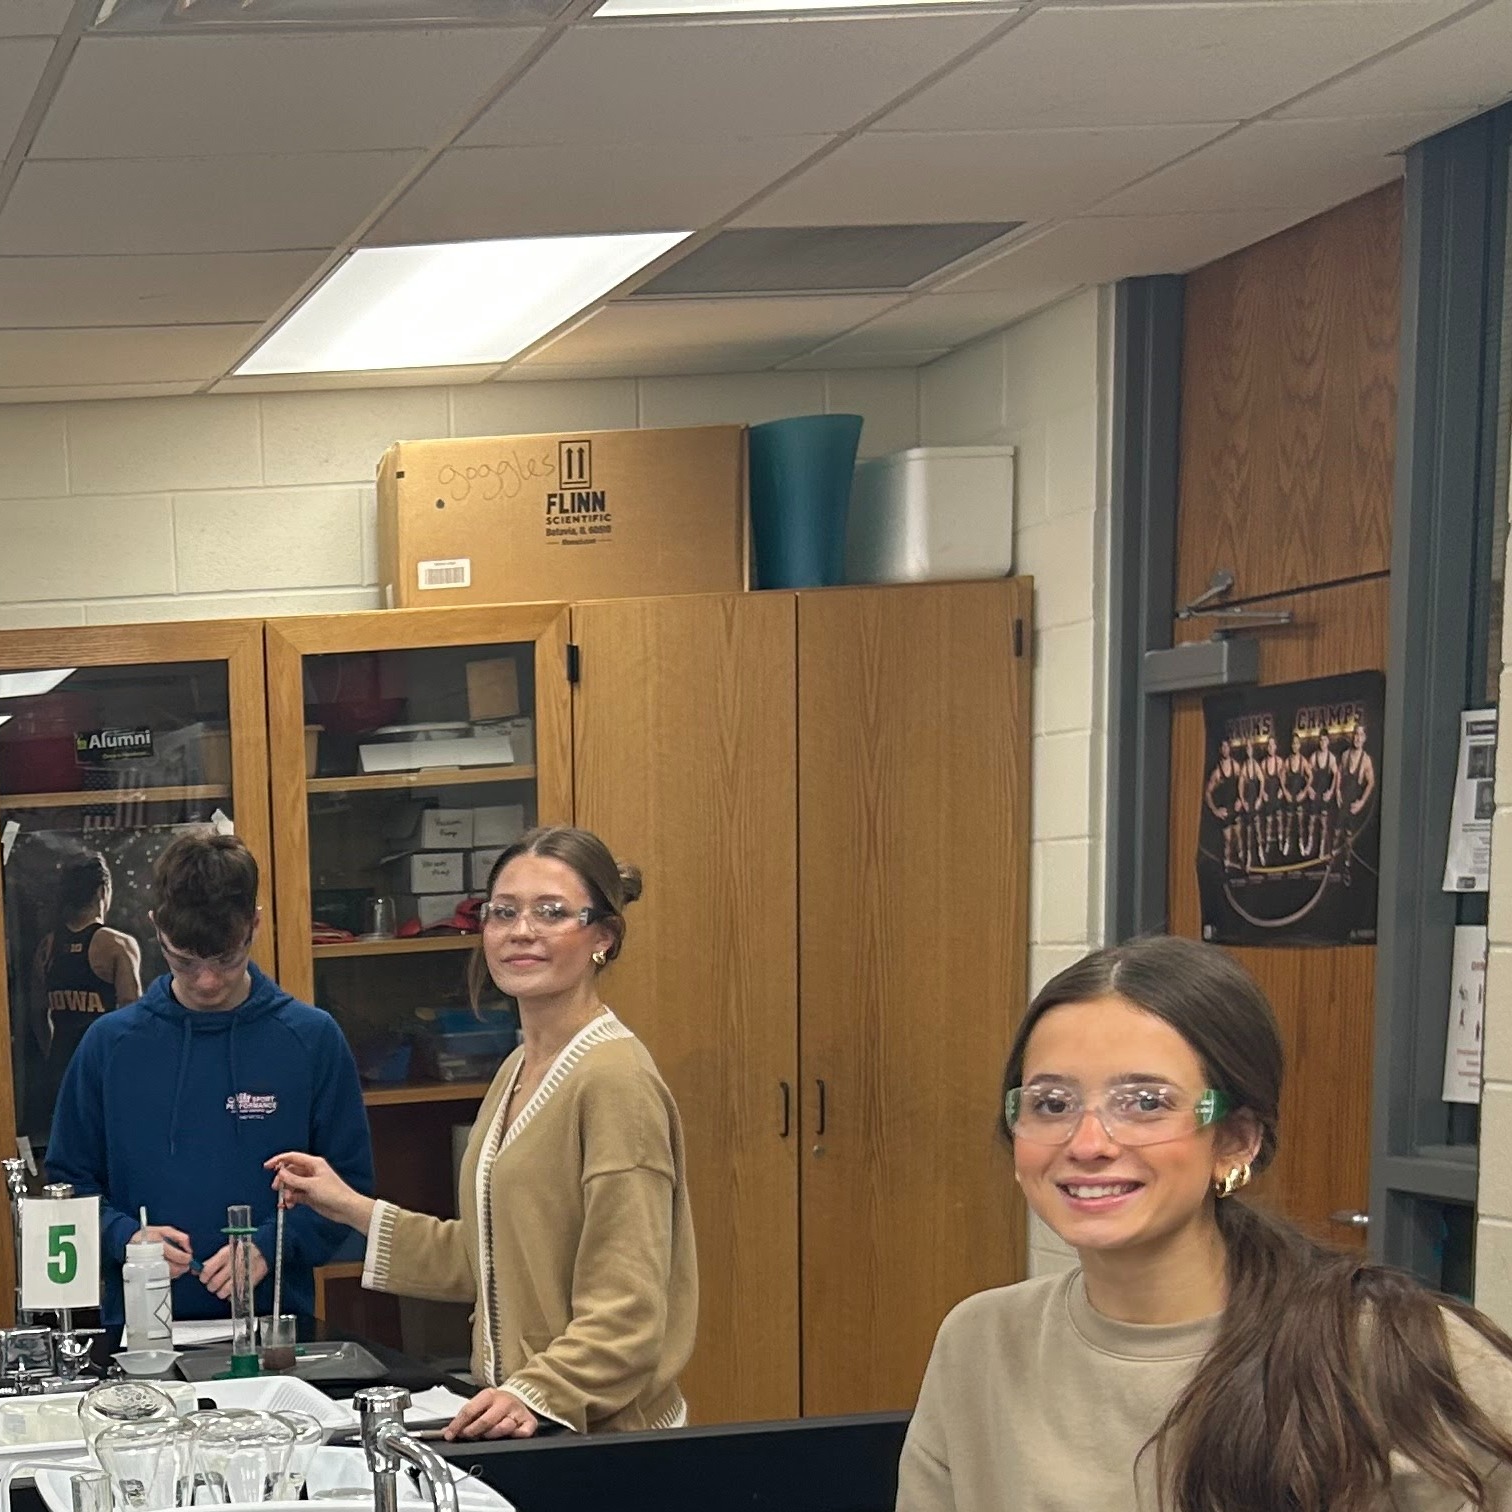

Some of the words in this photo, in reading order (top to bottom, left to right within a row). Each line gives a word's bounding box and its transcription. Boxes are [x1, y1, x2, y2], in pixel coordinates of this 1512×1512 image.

[439, 450, 555, 500] goggles
[546, 491, 605, 515] FLINN
[546, 514, 612, 525] SCIENTIFIC
[89, 729, 151, 749] Alumni
[49, 990, 106, 1013] IOWA
[47, 1224, 78, 1285] 5
